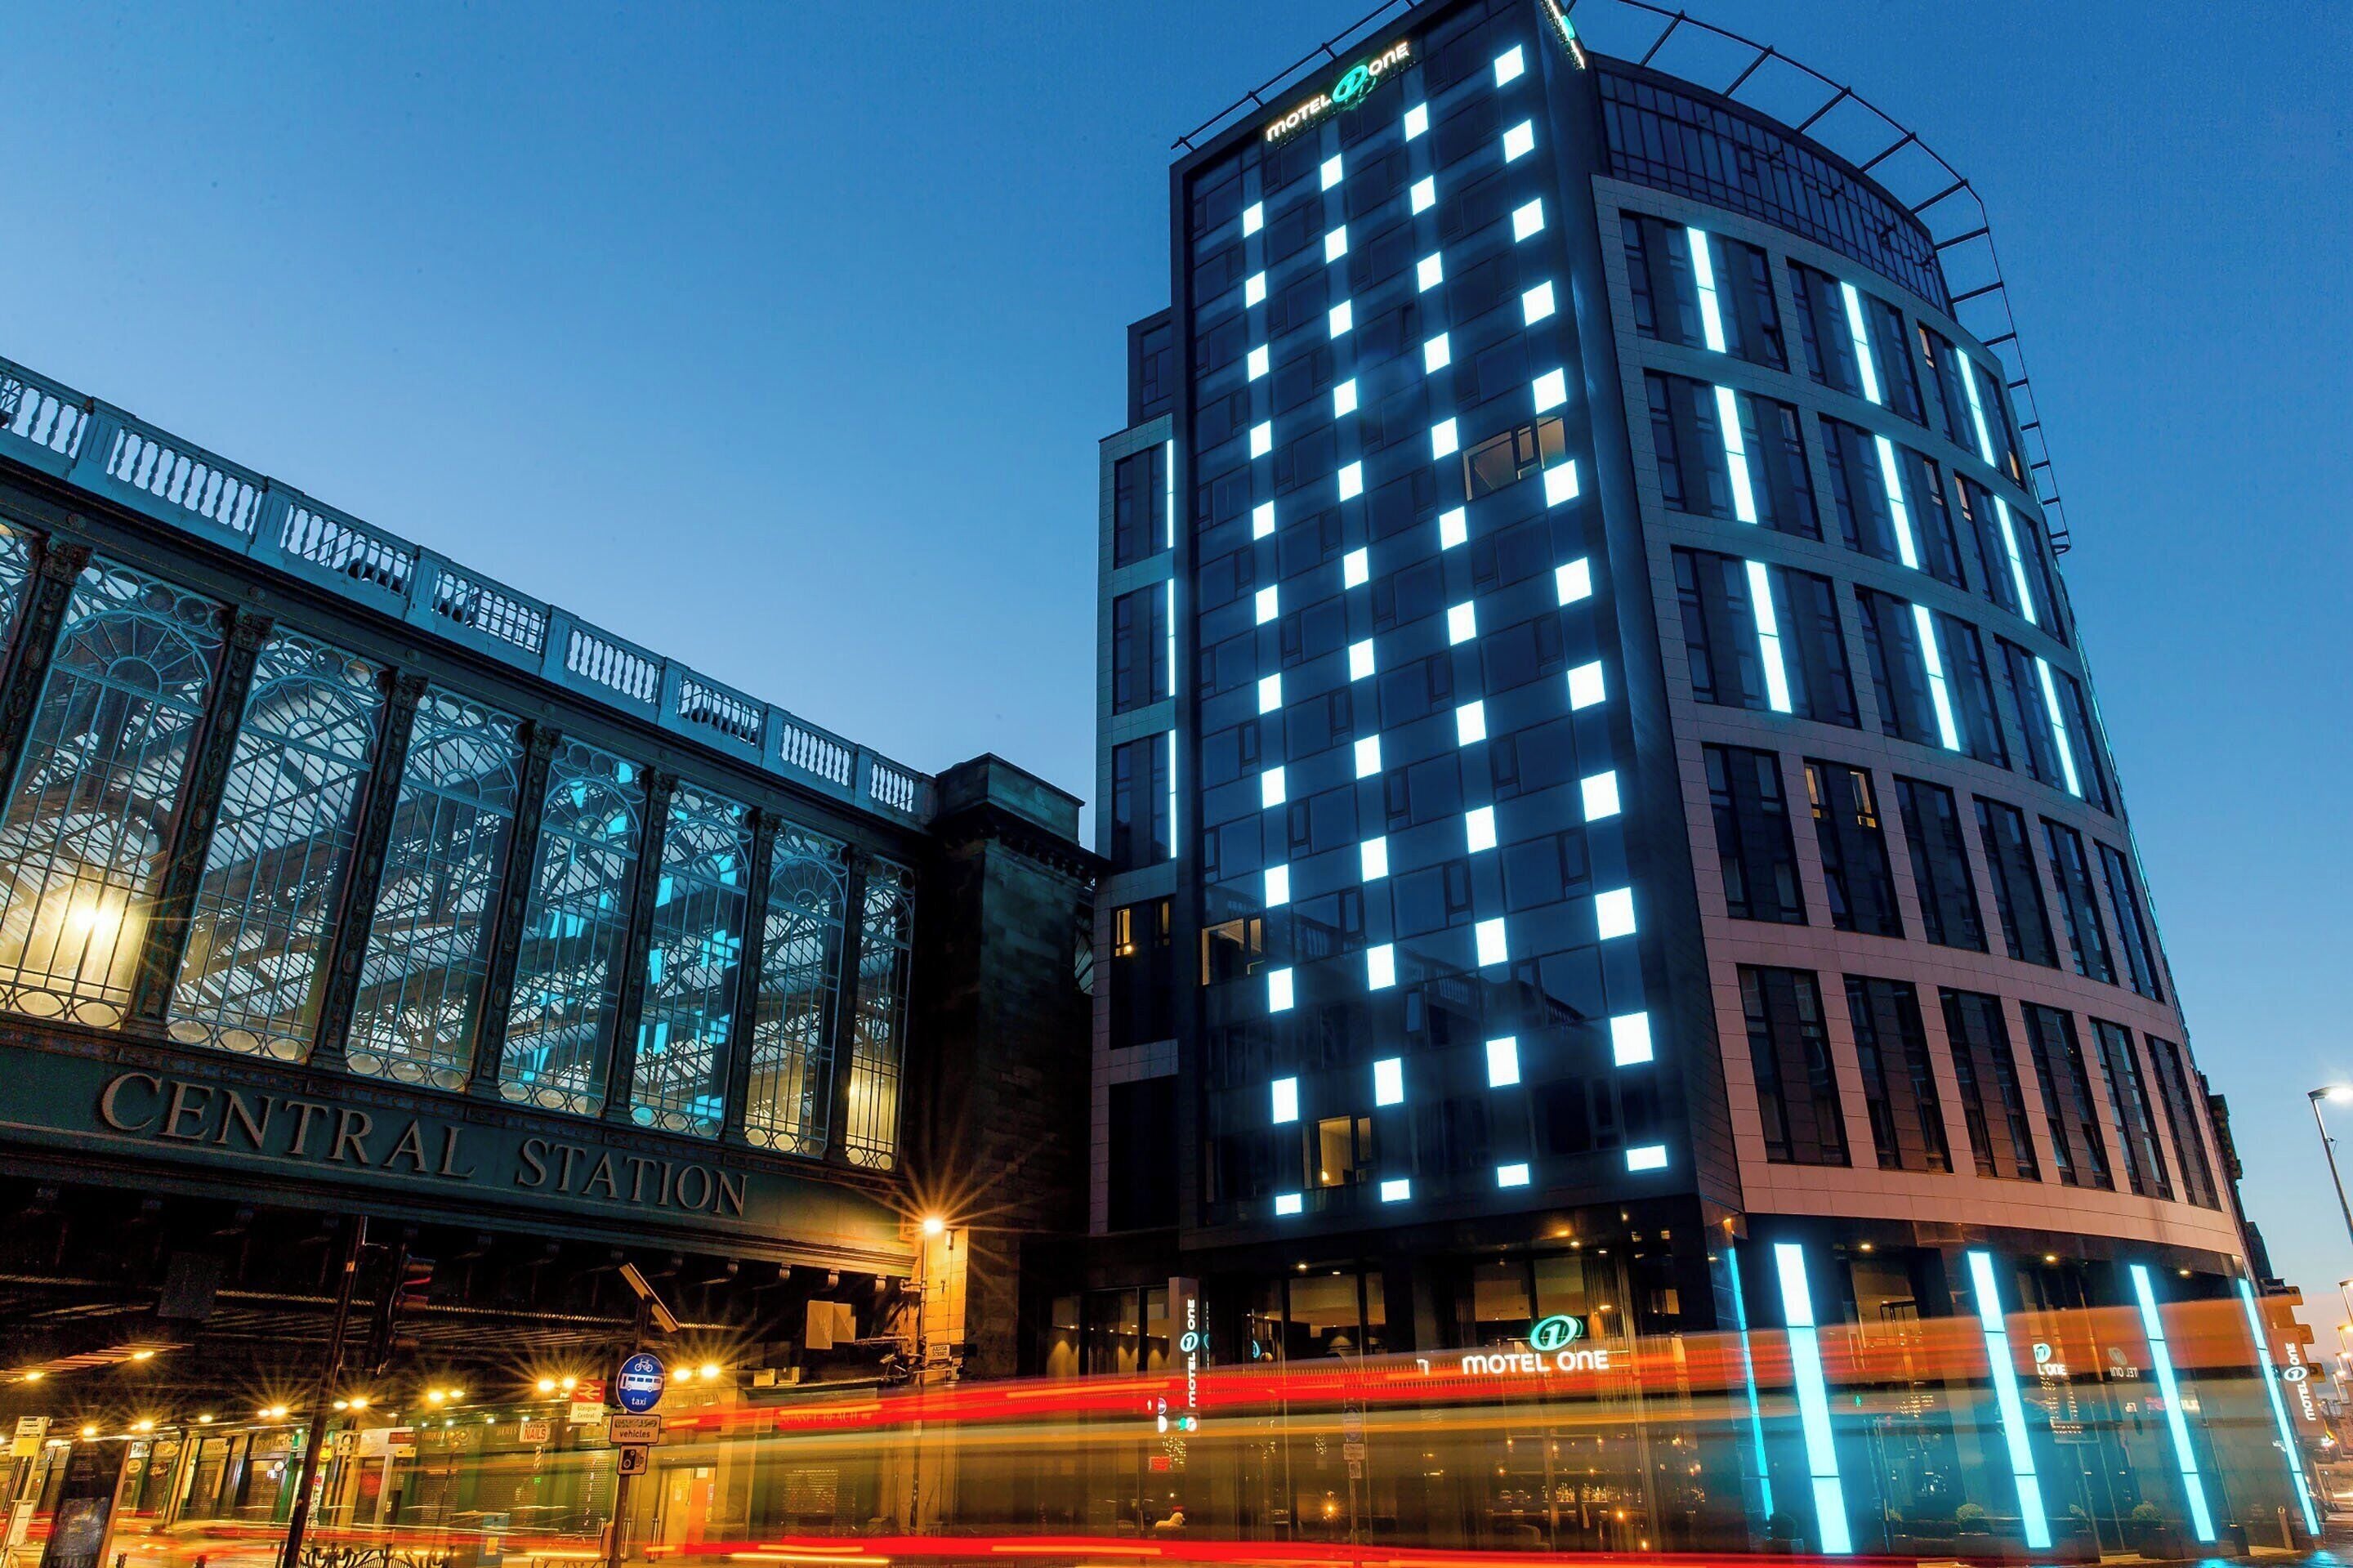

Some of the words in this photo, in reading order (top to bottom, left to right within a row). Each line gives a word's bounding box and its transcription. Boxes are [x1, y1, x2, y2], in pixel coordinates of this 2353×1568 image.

[1266, 94, 1333, 142] MOTEL
[1368, 41, 1410, 77] ONE
[101, 1072, 476, 1178] CENTRAL
[516, 1138, 749, 1217] STATION
[1186, 1299, 1196, 1330] ONE
[1462, 1355, 1551, 1374] MOTEL
[1556, 1350, 1610, 1371] ONE
[2285, 1342, 2300, 1365] ONE
[1187, 1352, 1197, 1407] MOTEL
[577, 1405, 597, 1413] Glasgow
[632, 1396, 647, 1406] taxi
[2297, 1380, 2317, 1421] MOTEL
[524, 1428, 547, 1440] NAILS
[619, 1430, 651, 1438] vehicles
